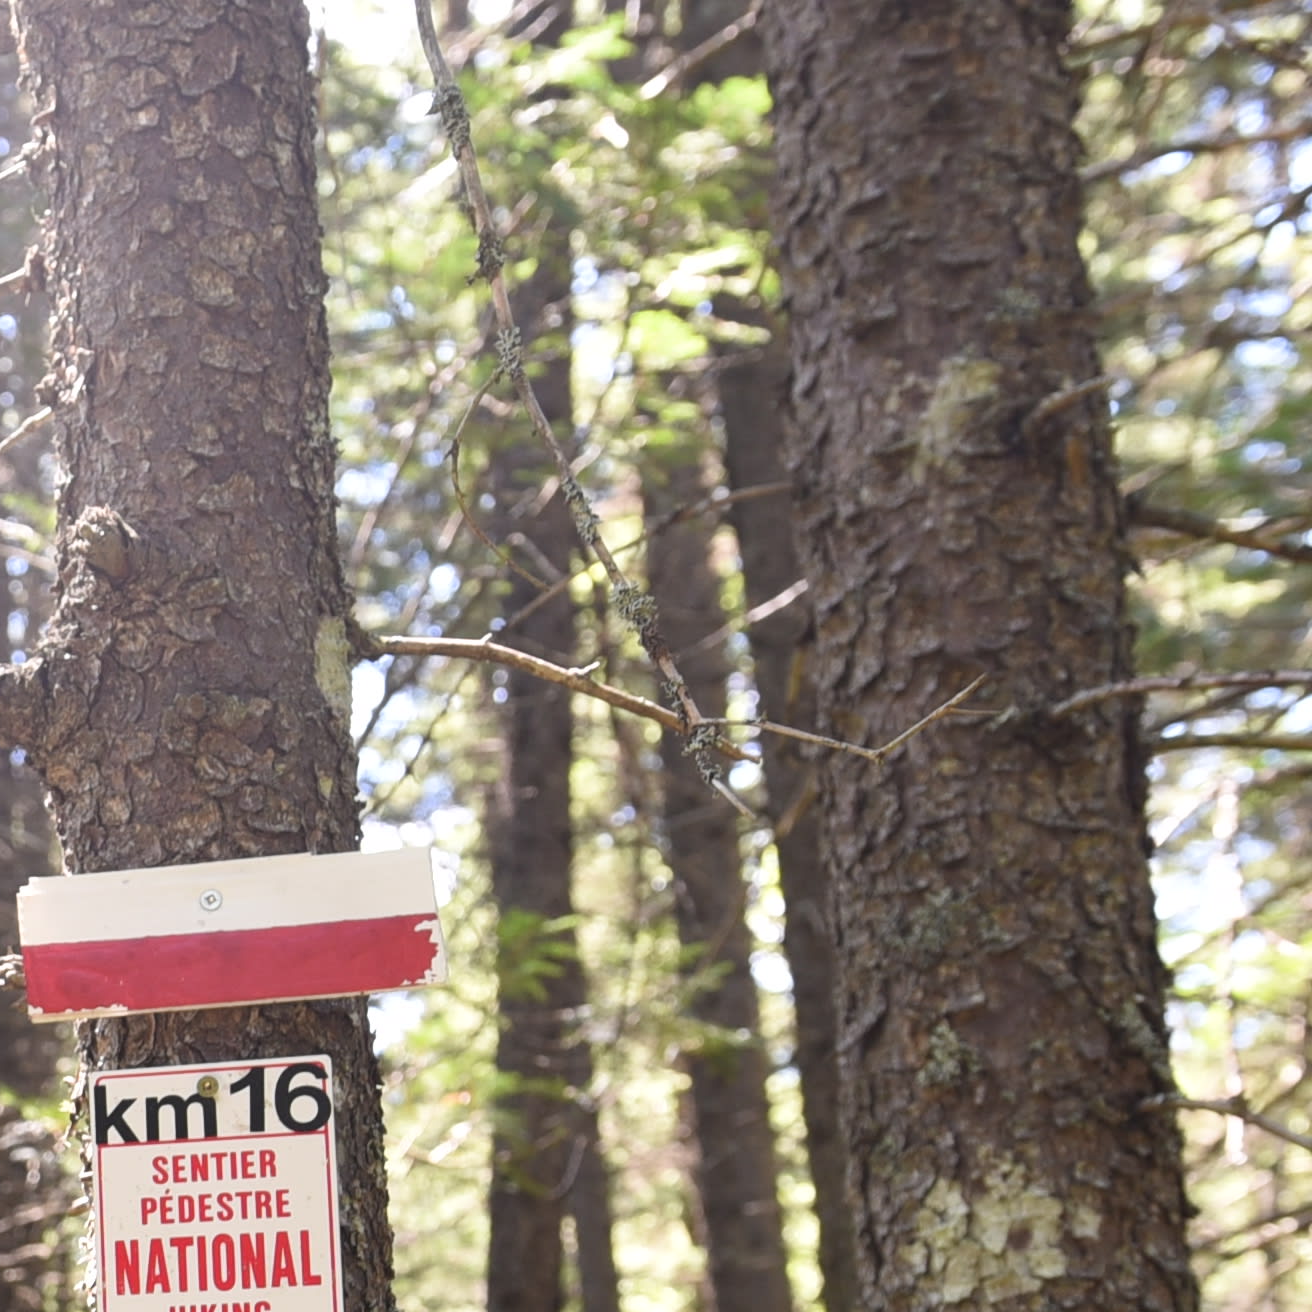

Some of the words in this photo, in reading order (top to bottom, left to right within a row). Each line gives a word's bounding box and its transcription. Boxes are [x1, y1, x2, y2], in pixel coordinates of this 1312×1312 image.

[151, 1149, 278, 1184] SENTIER
[140, 1189, 292, 1226] PÉDESTRE
[114, 1229, 322, 1296] NATIONAL
